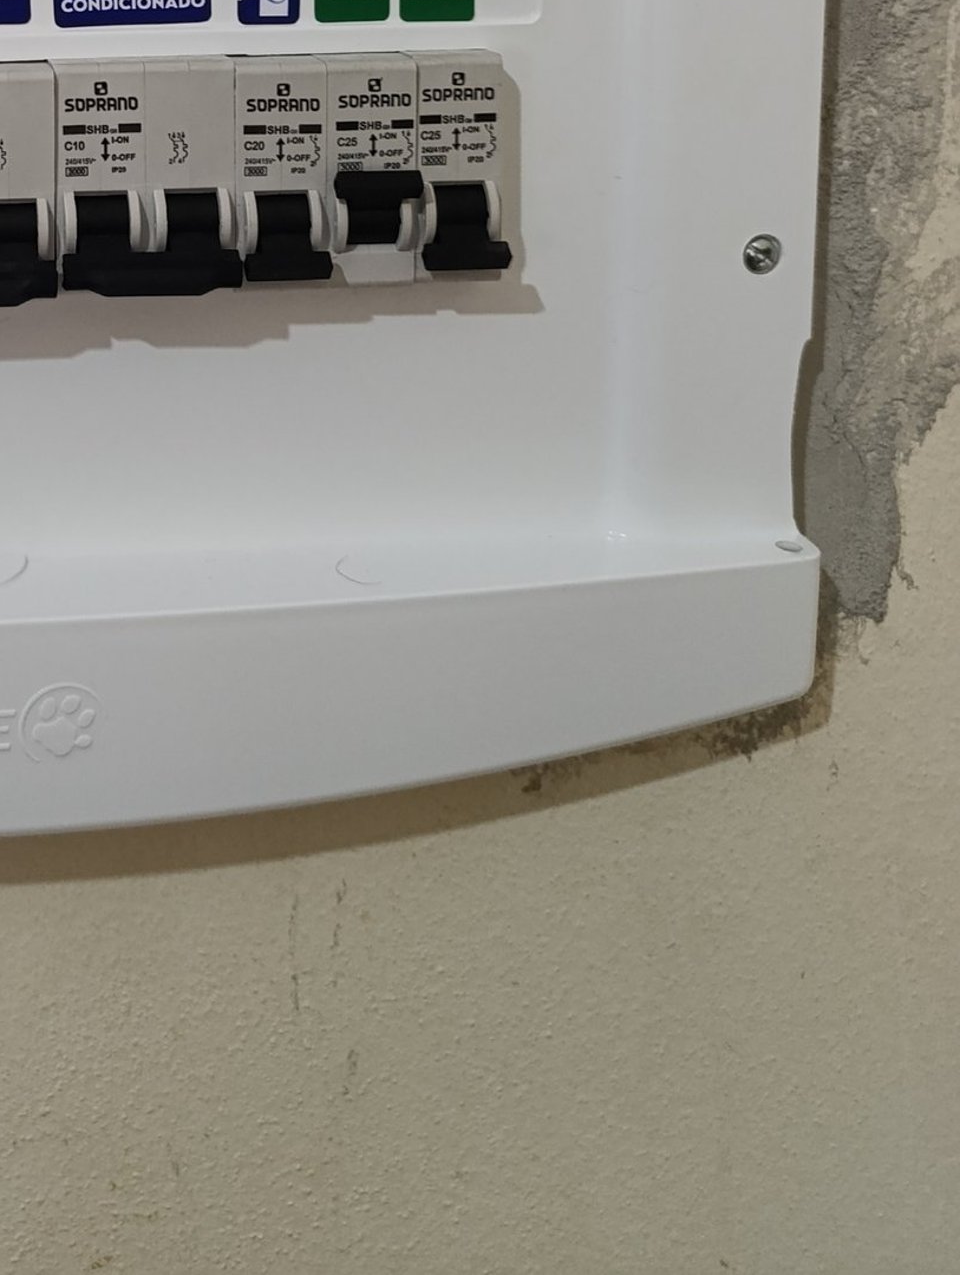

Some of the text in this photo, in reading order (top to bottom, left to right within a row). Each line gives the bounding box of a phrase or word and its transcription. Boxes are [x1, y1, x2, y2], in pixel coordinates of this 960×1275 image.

[422, 87, 495, 102] SOPRANO
[64, 97, 138, 112] SOPRANO
[246, 99, 320, 112] SOPRANO
[339, 93, 411, 108] SOPRANO
[421, 131, 441, 141] C25
[64, 141, 85, 151] C10
[244, 141, 264, 151] C20
[337, 137, 358, 147] C25
